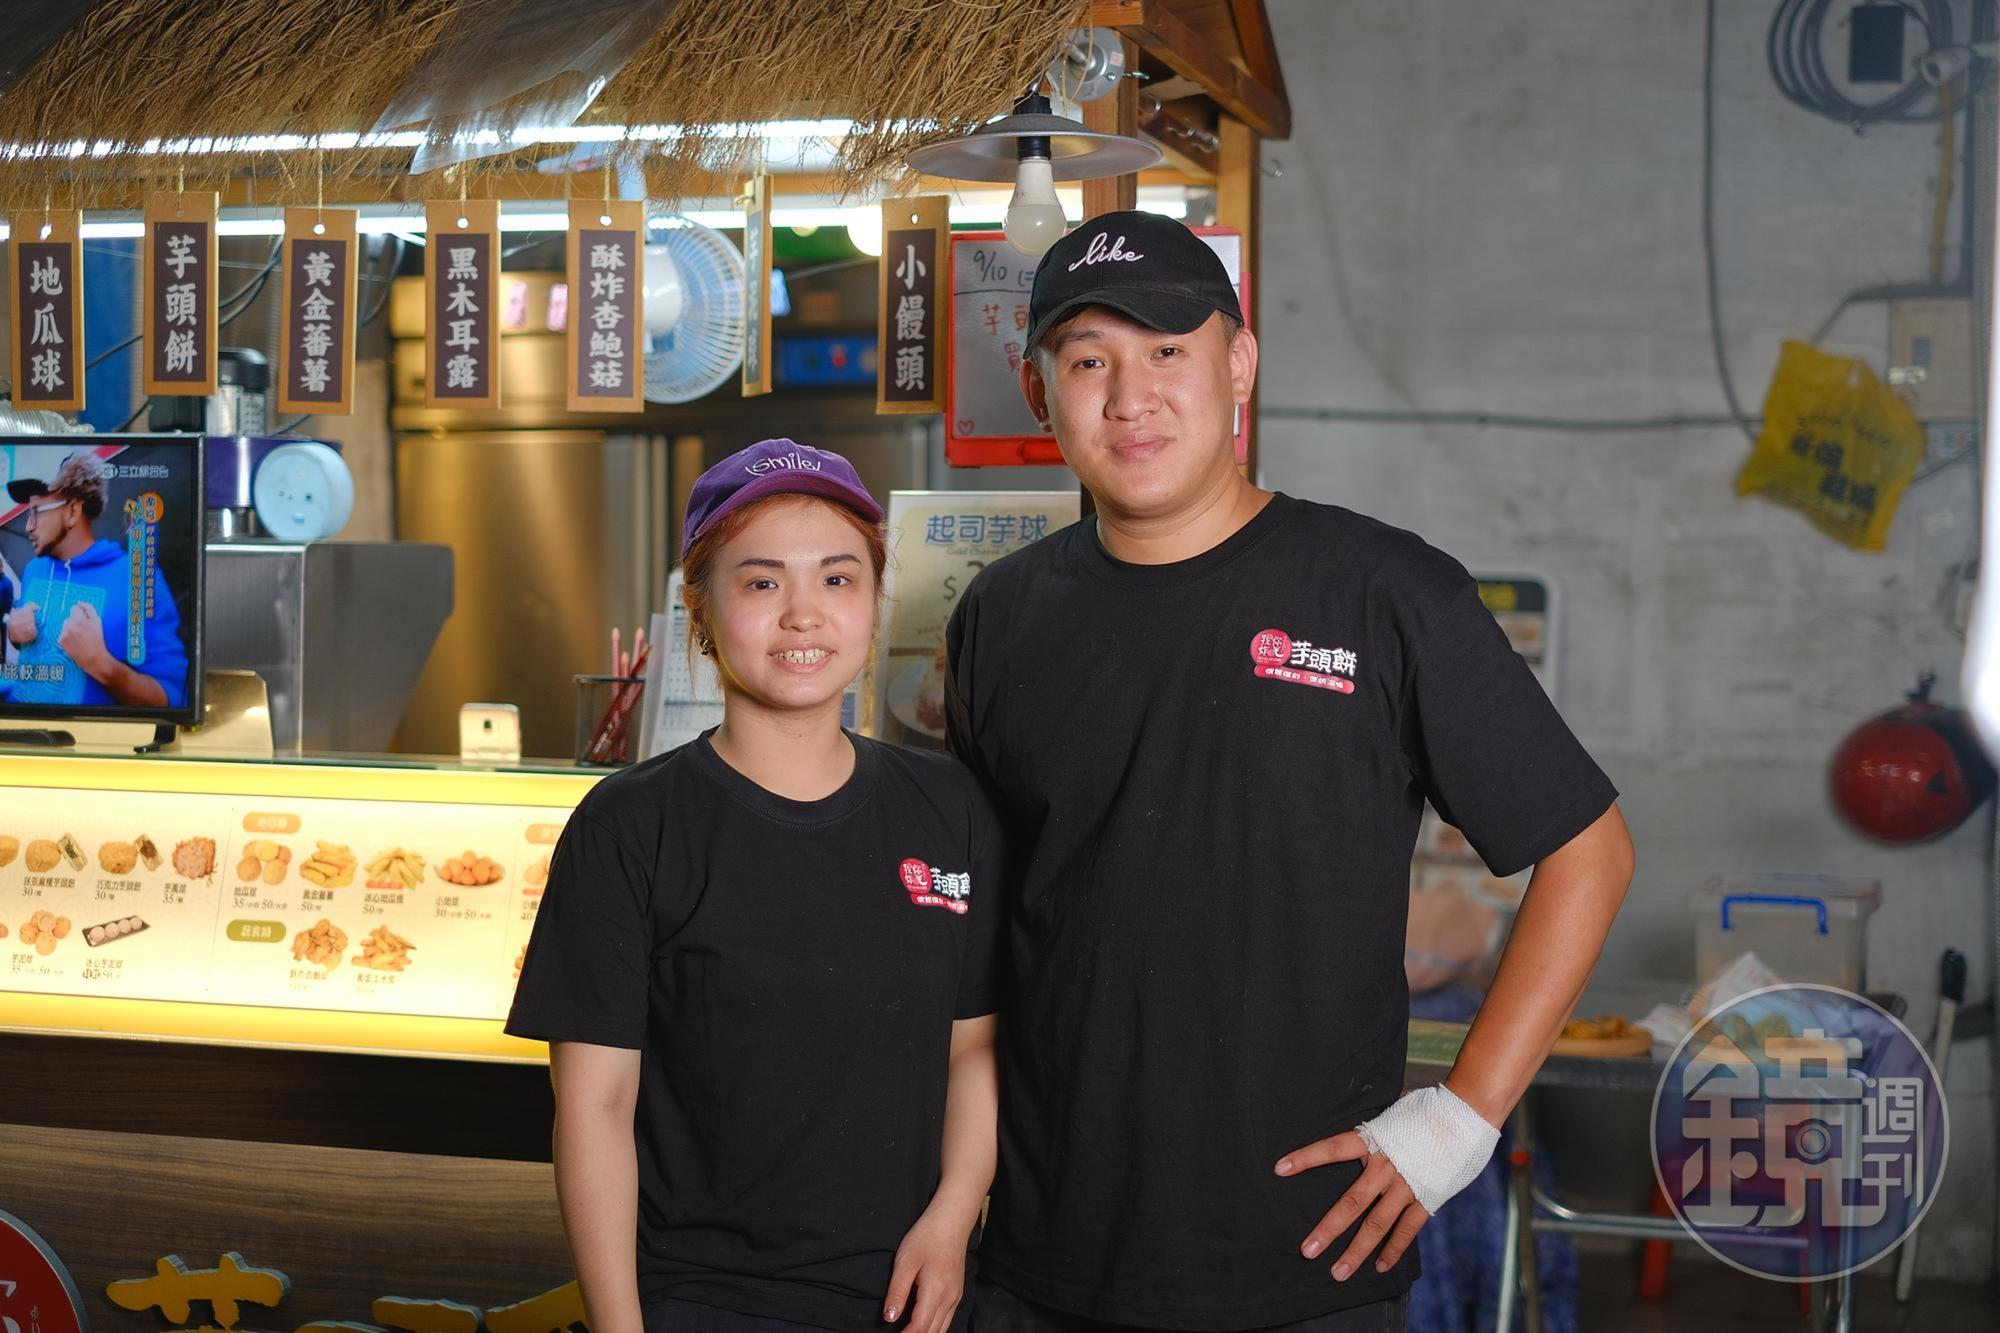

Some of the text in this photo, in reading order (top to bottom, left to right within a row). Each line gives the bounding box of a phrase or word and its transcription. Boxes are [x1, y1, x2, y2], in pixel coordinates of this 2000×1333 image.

[163, 235, 199, 375] 芋頭餅
[445, 246, 481, 390] 黑木耳露
[589, 244, 627, 389] 酥炸杏鮑菇
[895, 244, 927, 392] 小饅頭
[973, 249, 1008, 282] 9/10
[1068, 231, 1144, 273] like
[29, 256, 66, 395] 地瓜球
[300, 251, 336, 394] 黃金蕃薯
[925, 514, 1049, 546] 起司芋球
[0, 663, 65, 682] 比較溫暖
[1290, 638, 1358, 678] 芋頭餅
